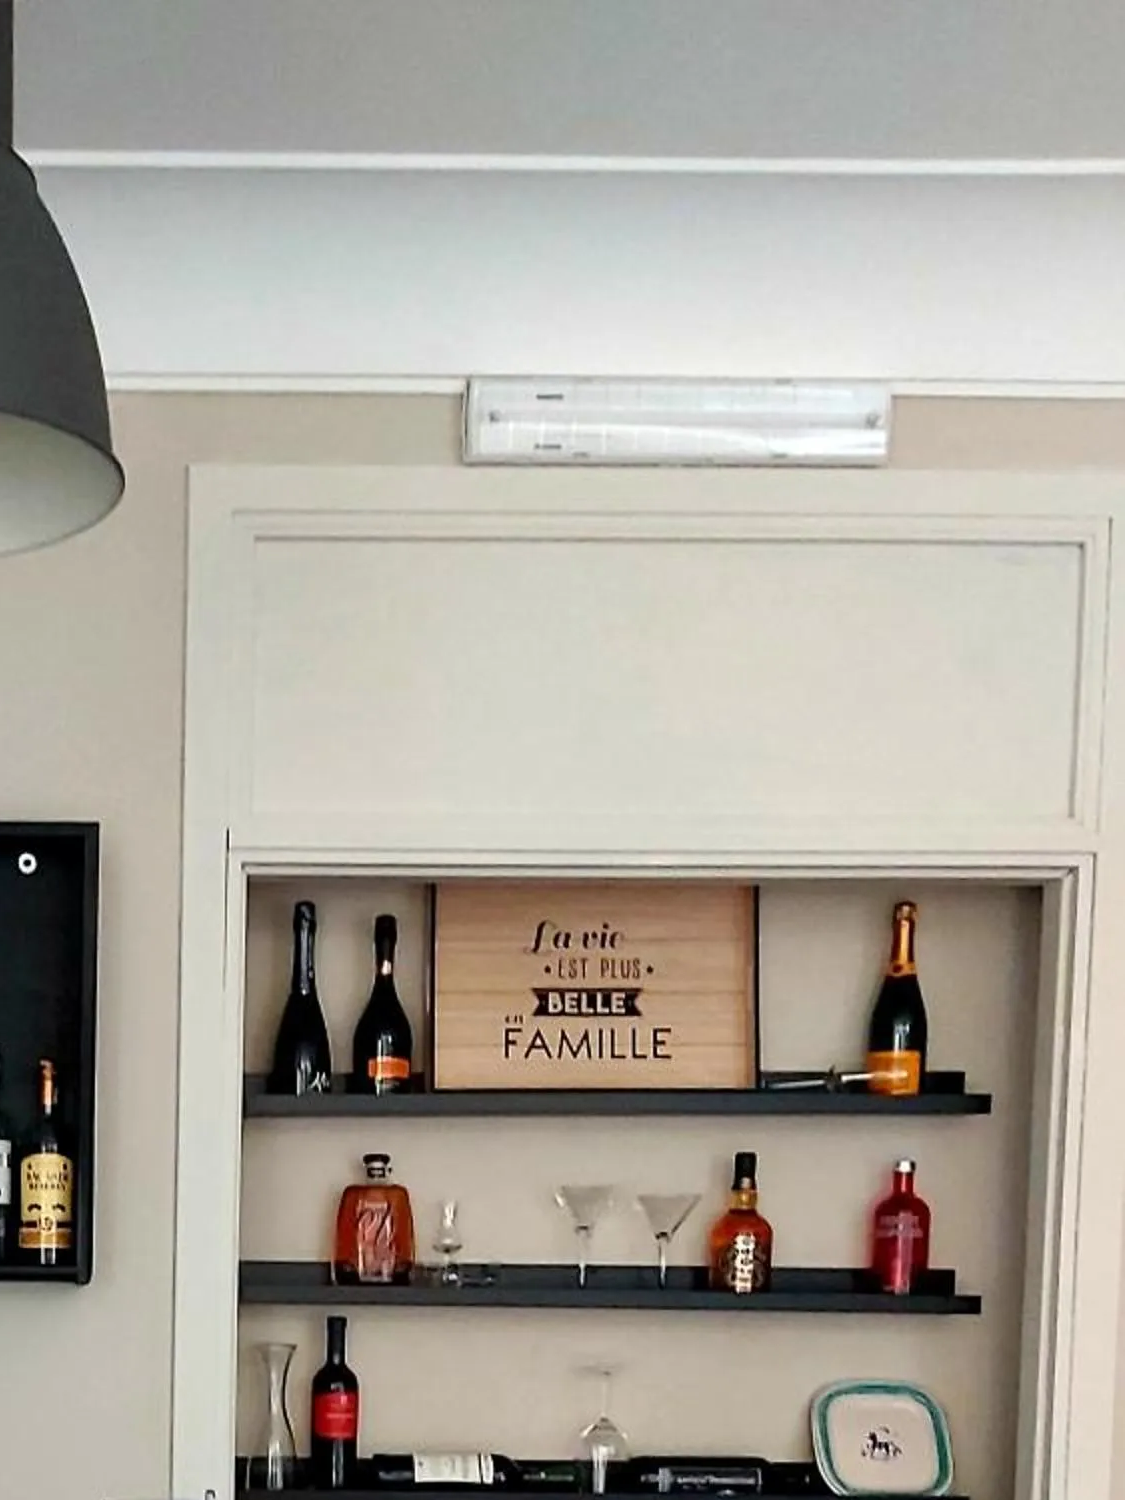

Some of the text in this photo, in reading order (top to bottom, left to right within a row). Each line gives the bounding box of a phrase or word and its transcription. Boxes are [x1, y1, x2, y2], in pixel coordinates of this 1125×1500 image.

[524, 920, 625, 954] La vie
[558, 958, 641, 979] EST PLUS
[548, 993, 626, 1014] BELLE
[503, 1028, 673, 1060] FAMILLE
